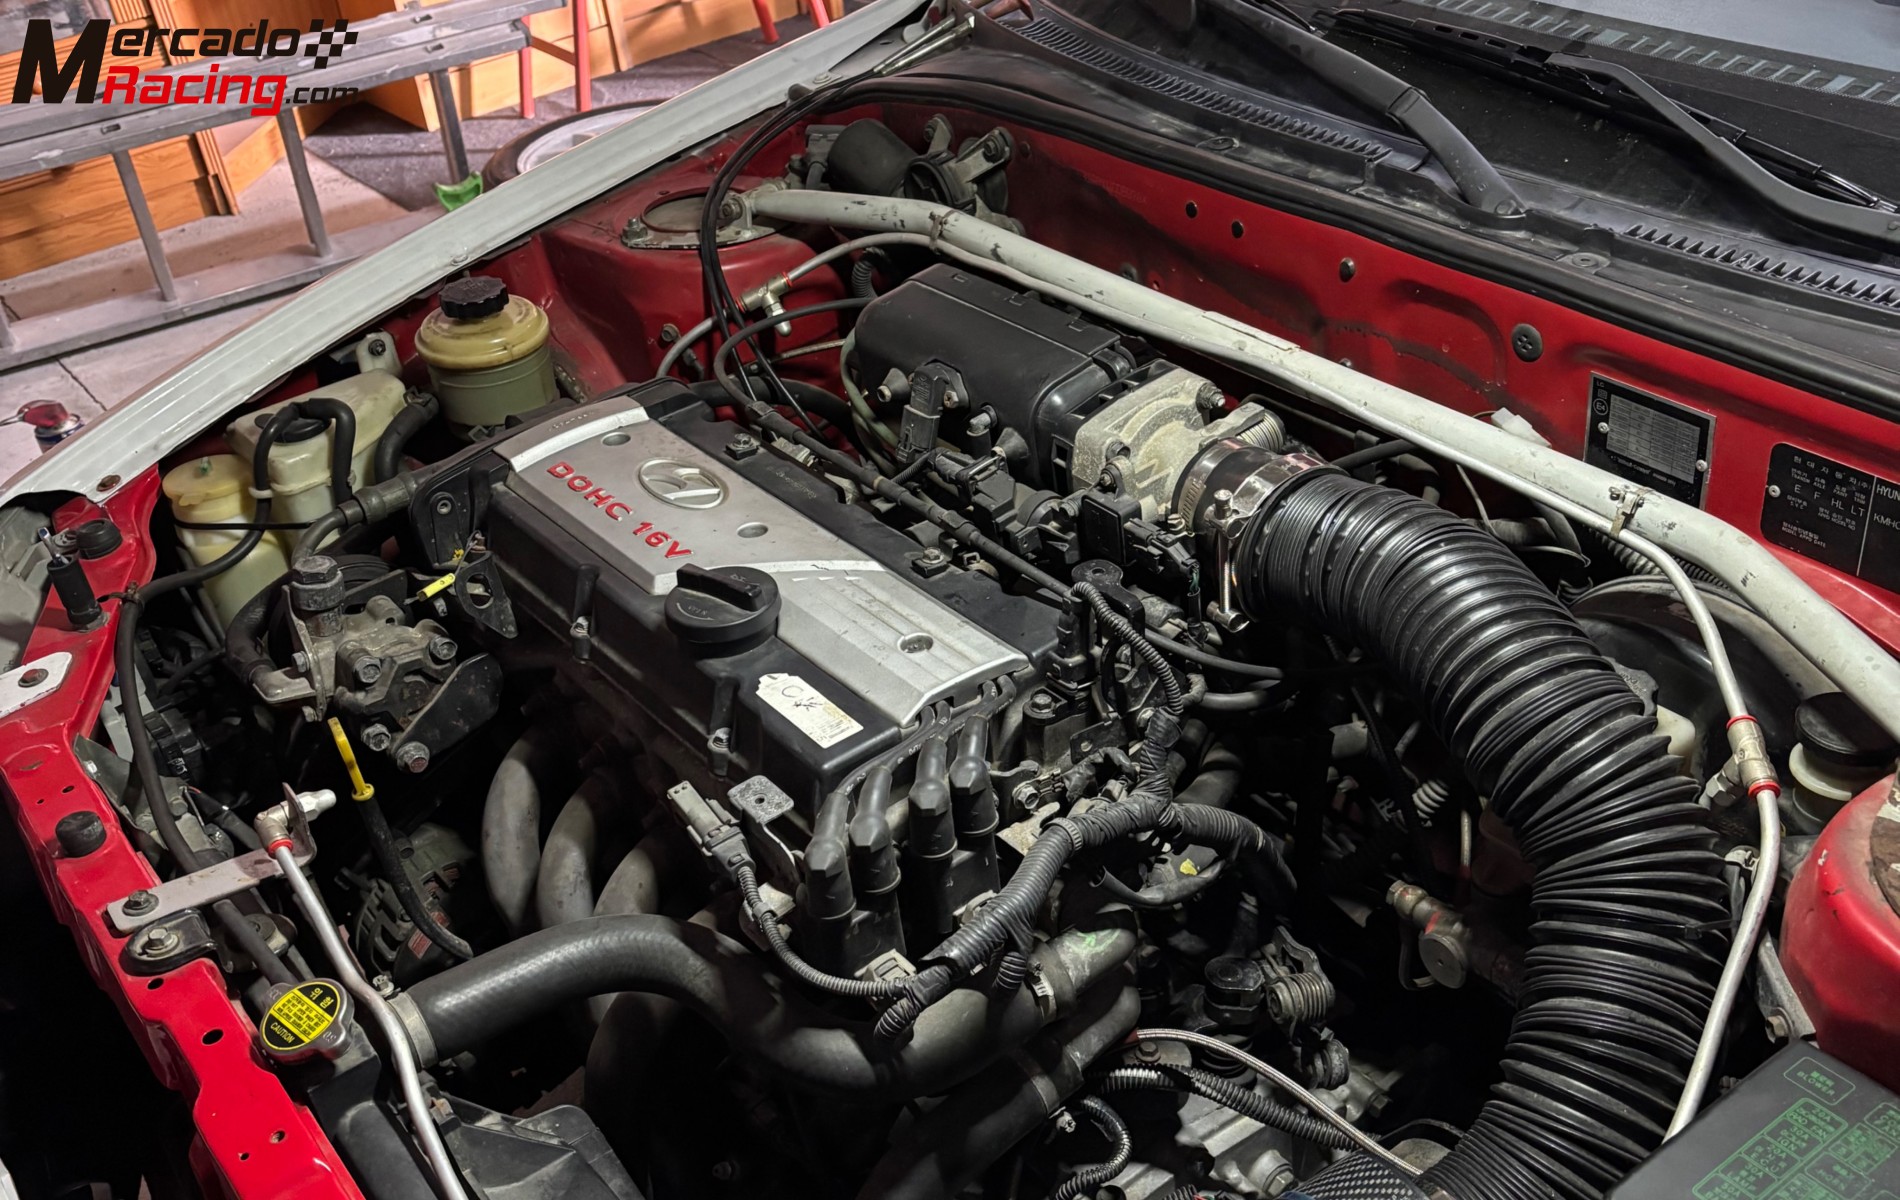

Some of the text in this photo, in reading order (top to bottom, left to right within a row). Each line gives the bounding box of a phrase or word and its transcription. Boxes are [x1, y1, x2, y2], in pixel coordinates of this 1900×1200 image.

[1794, 484, 1802, 494] E
[1814, 491, 1821, 500] F
[1831, 498, 1845, 511] HL
[546, 461, 694, 559] DOHC 16V
[310, 988, 334, 1009] 위험
[271, 1022, 295, 1043] CAUTION
[1796, 1071, 1836, 1096] BLOWER
[1777, 1136, 1798, 1151] IGN
